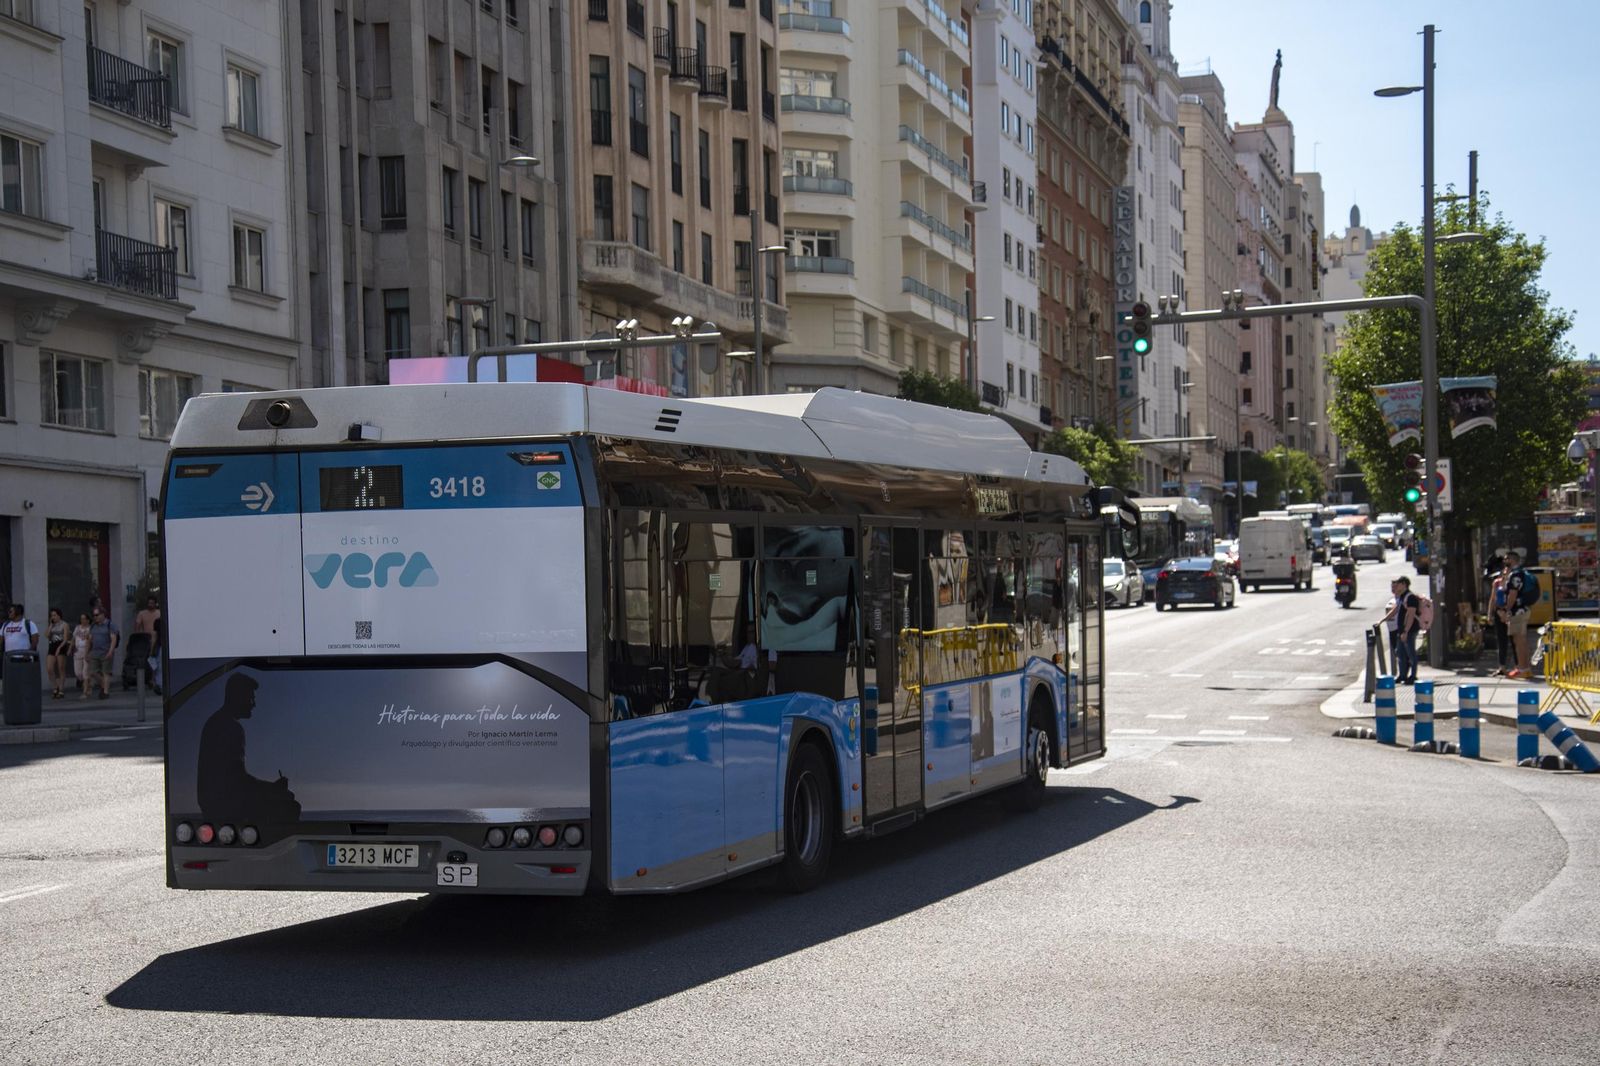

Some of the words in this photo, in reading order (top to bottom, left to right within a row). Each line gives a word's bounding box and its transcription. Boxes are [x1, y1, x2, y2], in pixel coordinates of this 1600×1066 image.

[1115, 189, 1134, 303] SENATOR
[429, 476, 486, 499] 3418
[541, 477, 557, 485] GNC
[340, 536, 400, 546] destino
[377, 704, 441, 725] Historias
[440, 712, 477, 728] para
[476, 704, 509, 725] toda
[511, 704, 529, 721] la
[528, 704, 561, 721] vida
[447, 739, 485, 748] divulgador
[467, 730, 480, 738] Por
[481, 730, 508, 739] Ignacio
[508, 730, 534, 738] Martín
[534, 730, 558, 738] Lerma
[337, 846, 377, 865] 3213
[382, 847, 414, 865] MCF
[441, 865, 473, 884] SP
